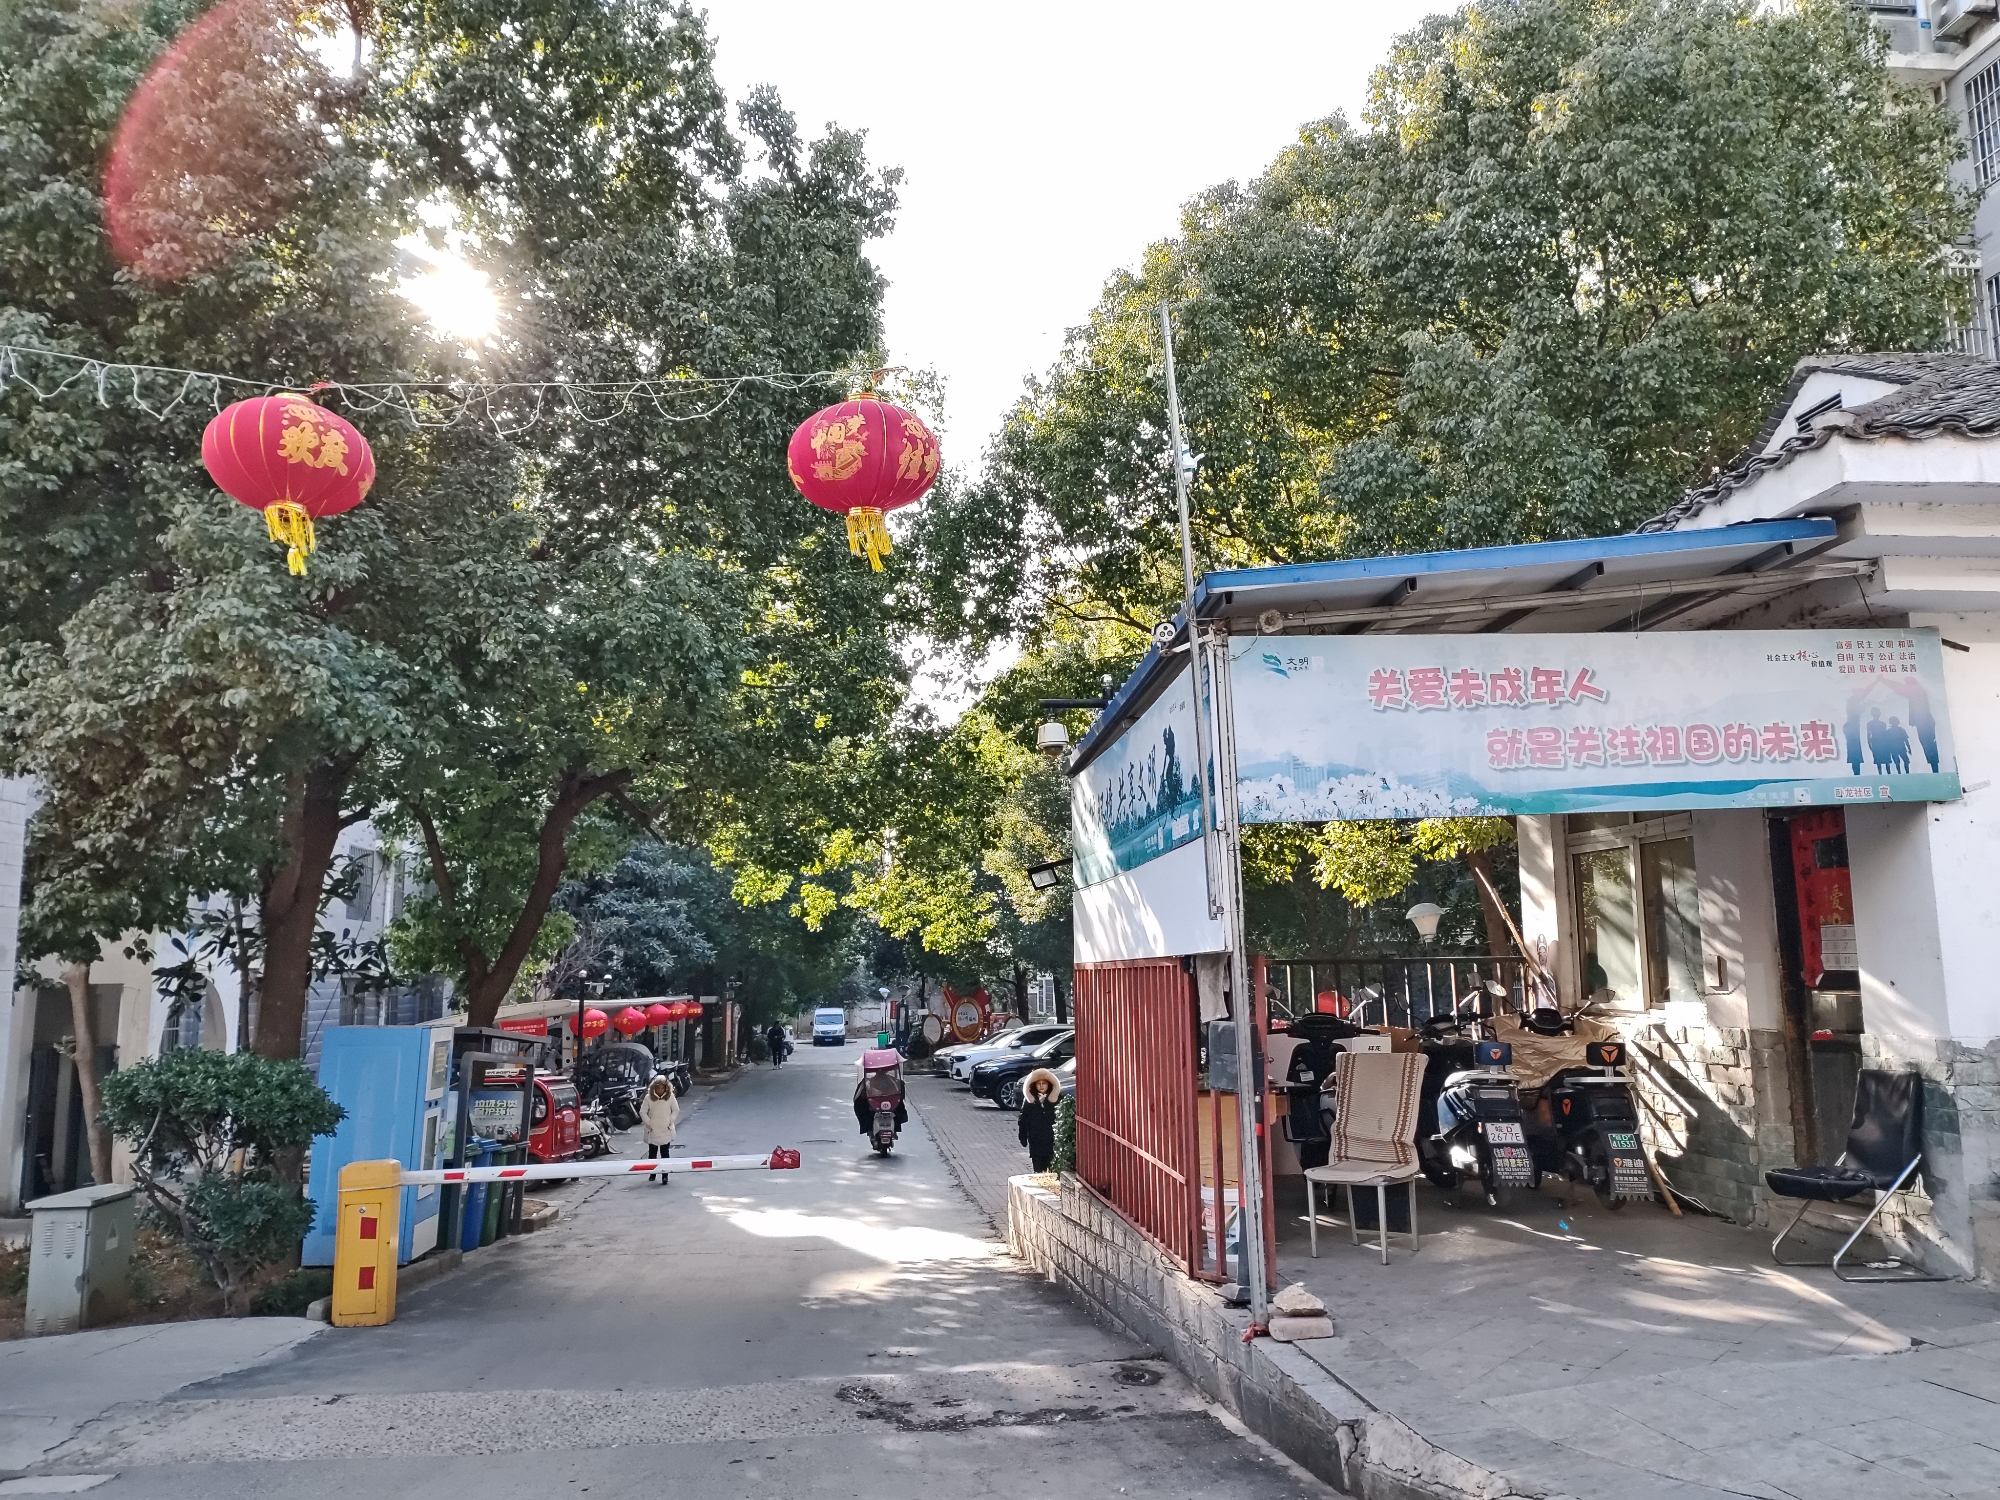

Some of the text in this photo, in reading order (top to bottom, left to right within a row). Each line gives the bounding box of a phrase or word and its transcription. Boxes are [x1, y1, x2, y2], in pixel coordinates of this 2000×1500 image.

[1836, 639, 1915, 650] 富强 民主 文明 和谐
[1286, 656, 1309, 666] 文明
[1837, 652, 1916, 662] 自由 平等 公正 法治
[1811, 660, 1833, 668] 价值观
[1838, 663, 1917, 674] 爱国 敬业 诚信 友善
[1367, 666, 1606, 708] 关爱未成年人
[1486, 719, 1836, 767] 就是关注祖国的未来
[1835, 786, 1890, 798] 卧龙社区 宣
[473, 1099, 518, 1108] 垃圾分类
[1490, 1132, 1522, 1142] 2677E
[1612, 1140, 1636, 1148] 4153T
[1622, 1158, 1645, 1168] 雅迪
